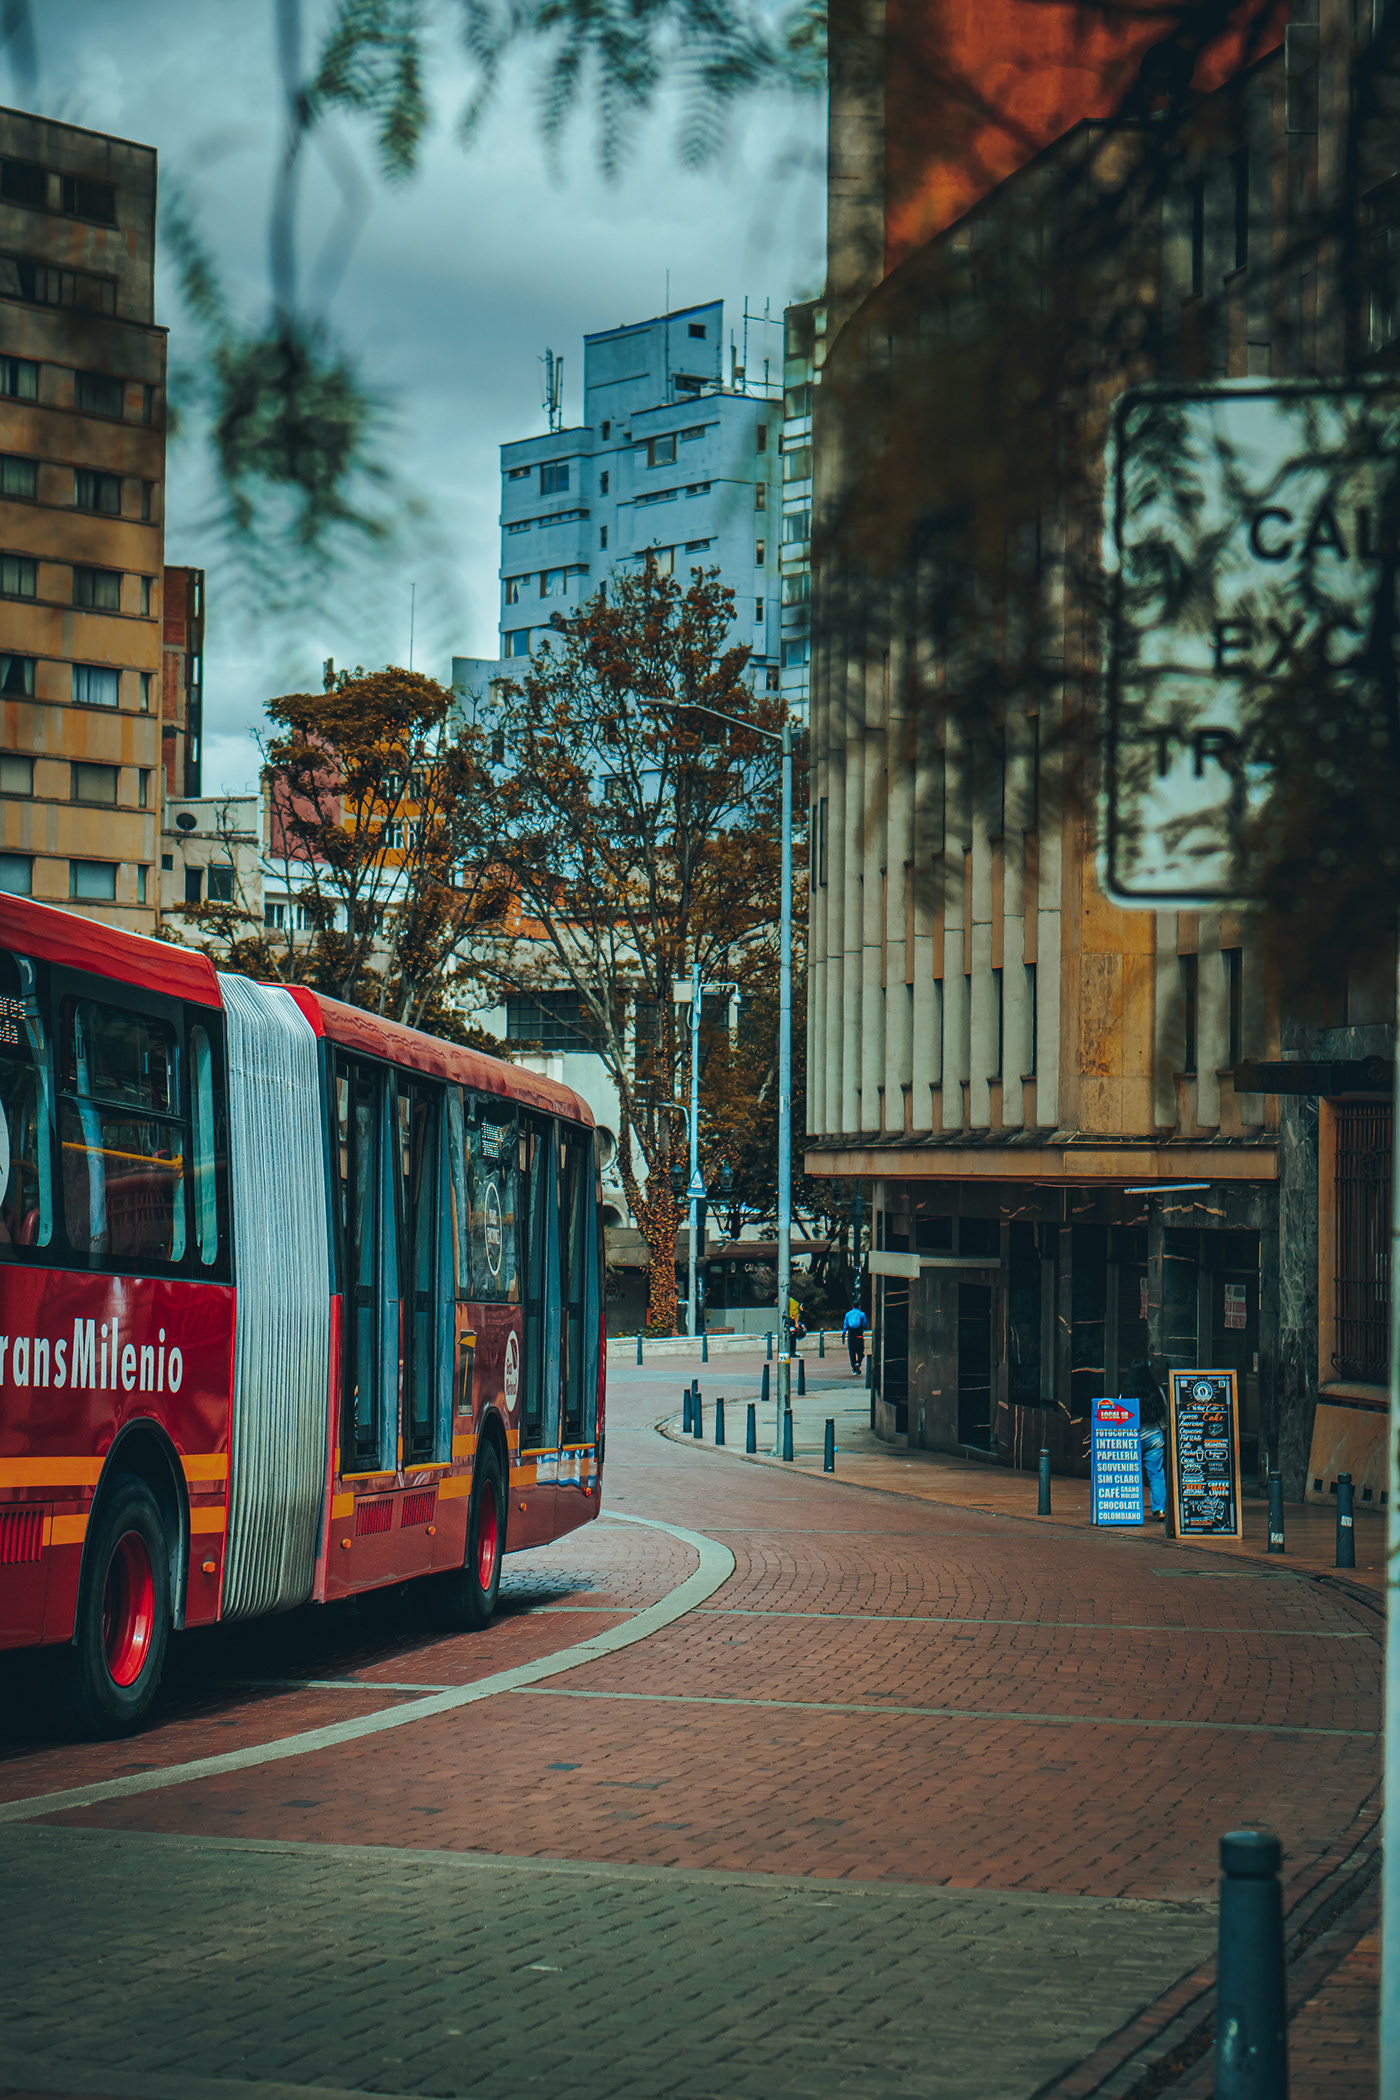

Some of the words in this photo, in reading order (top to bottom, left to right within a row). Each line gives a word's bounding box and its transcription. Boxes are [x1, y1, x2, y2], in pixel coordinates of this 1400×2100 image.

[1101, 1411, 1120, 1419] LOCAL
[1202, 1412, 1225, 1422] Cake
[1096, 1428, 1138, 1437] FOTOCOPIAS
[1096, 1439, 1138, 1449] INTERNET
[1097, 1450, 1139, 1460] PAPELERÍA
[1097, 1462, 1139, 1472] SOUVENIRS
[1098, 1474, 1112, 1483] SIM
[1114, 1474, 1139, 1483] CLARO
[1098, 1486, 1120, 1498] CAFÉ
[1098, 1501, 1140, 1510] CHOCOLATE
[1098, 1512, 1141, 1520] COLOMBIANO
